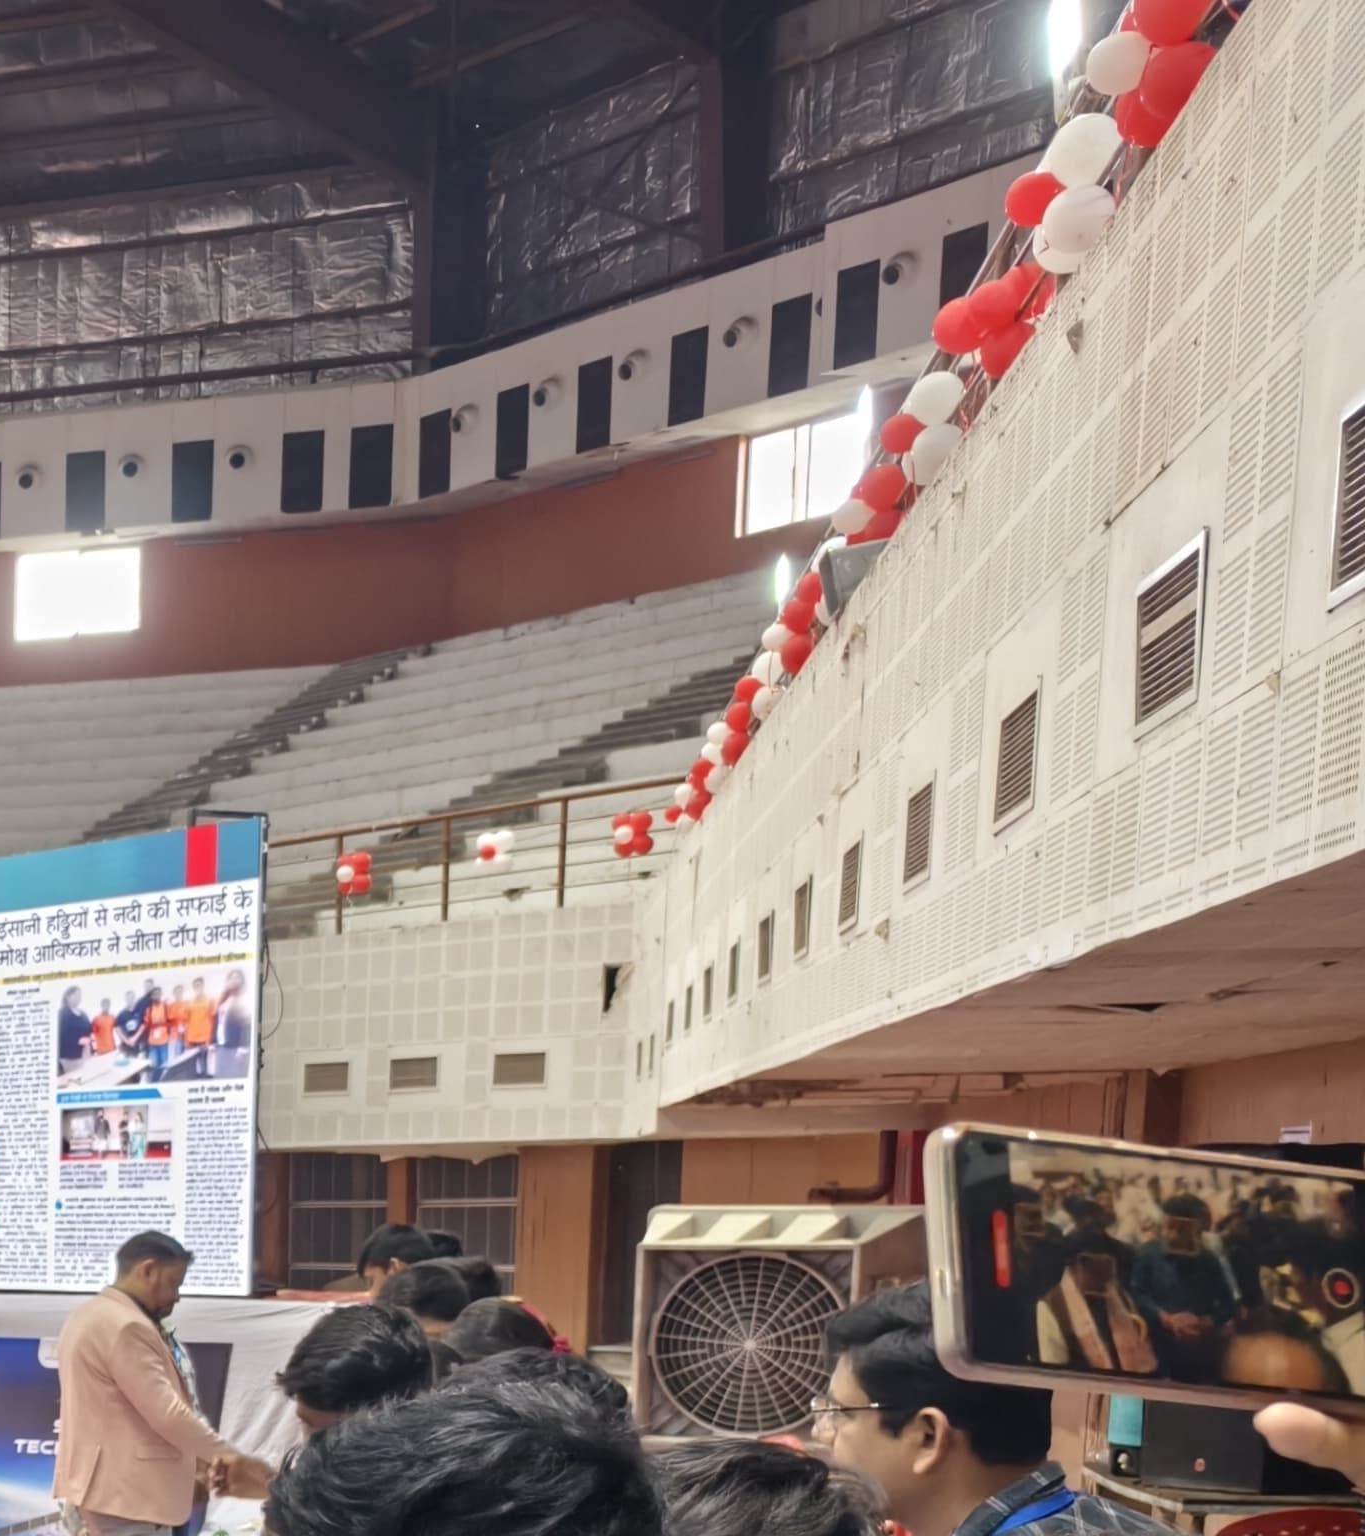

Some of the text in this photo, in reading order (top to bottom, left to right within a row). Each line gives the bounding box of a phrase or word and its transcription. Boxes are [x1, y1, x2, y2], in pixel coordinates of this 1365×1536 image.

[33, 936, 101, 963] आविष्कार
[107, 930, 121, 954] ने
[126, 927, 163, 953] जीता
[168, 923, 198, 948] टॉप
[203, 914, 251, 942] अवॉर्ड
[46, 906, 89, 940] हड्डियों
[94, 904, 109, 927] से
[113, 899, 142, 924] नदी
[147, 896, 170, 919] की
[175, 886, 228, 917] सफाई
[233, 885, 253, 910] के
